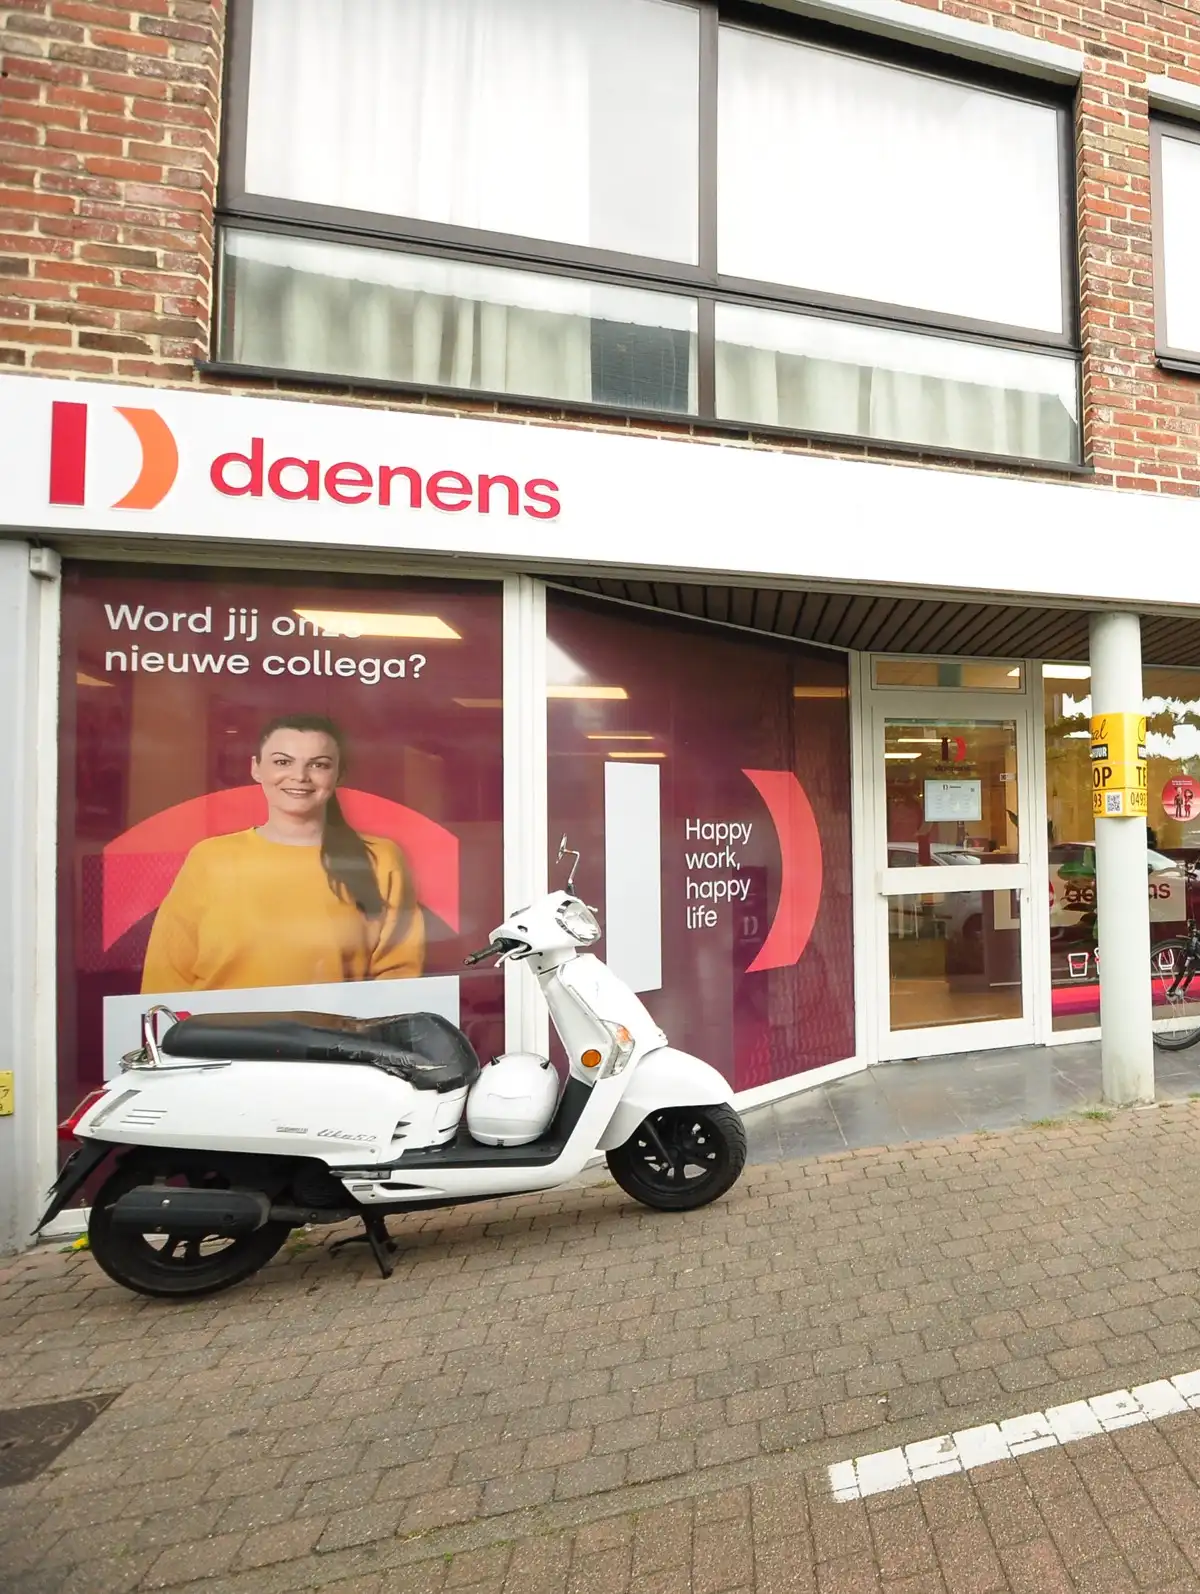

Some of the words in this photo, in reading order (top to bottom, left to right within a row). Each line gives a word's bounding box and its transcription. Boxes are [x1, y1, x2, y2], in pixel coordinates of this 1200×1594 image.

[210, 437, 562, 520] daenens
[104, 603, 212, 632] Word
[223, 607, 259, 642] jij
[271, 614, 363, 639] on
[104, 645, 250, 675] nieuwe
[261, 650, 427, 685] collega?
[685, 818, 752, 846] Happy
[685, 845, 741, 870] work,
[686, 876, 751, 903] happy
[686, 905, 718, 929] life
